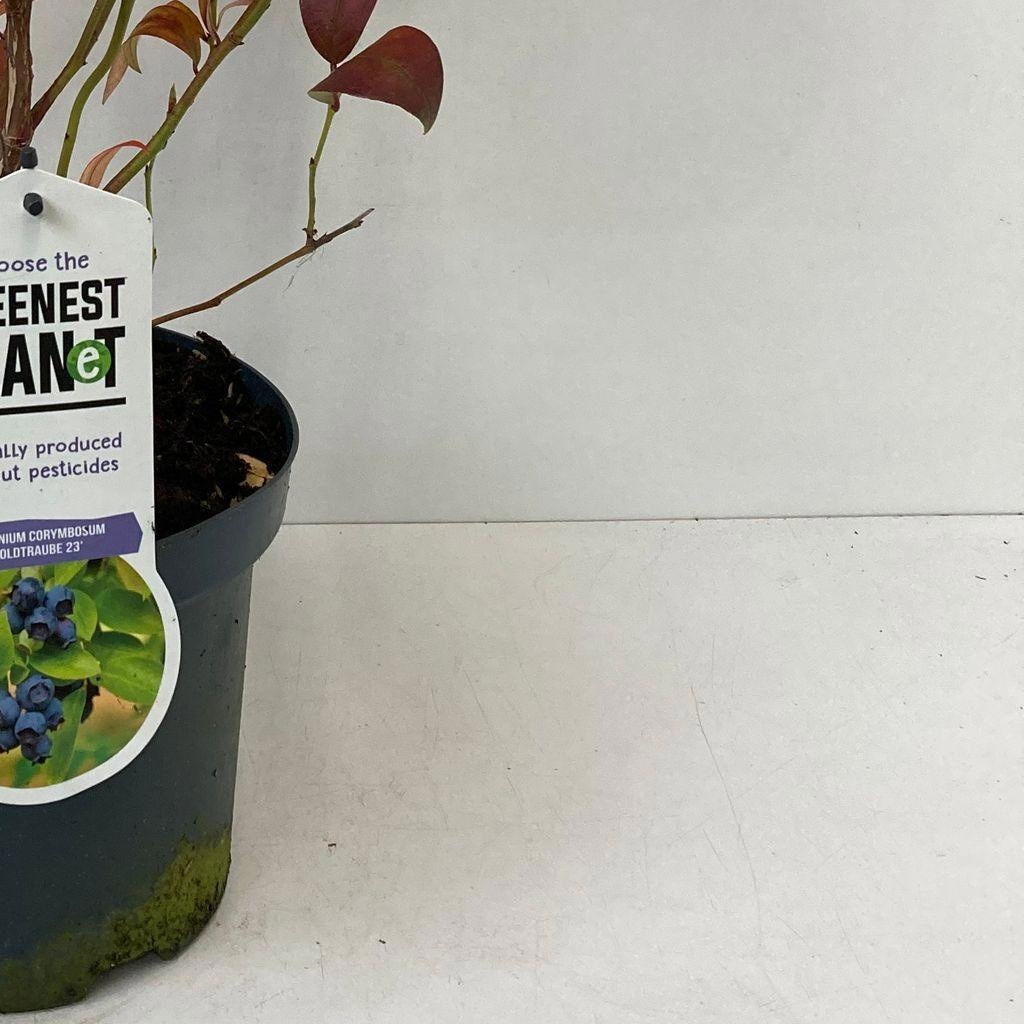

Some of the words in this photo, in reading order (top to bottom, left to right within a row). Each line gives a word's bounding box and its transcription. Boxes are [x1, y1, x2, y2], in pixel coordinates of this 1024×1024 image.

[54, 252, 89, 270] the
[36, 432, 122, 458] produced
[29, 457, 119, 482] pesticides
[28, 523, 106, 542] CORYMBOSUM
[65, 540, 84, 554] 23'
